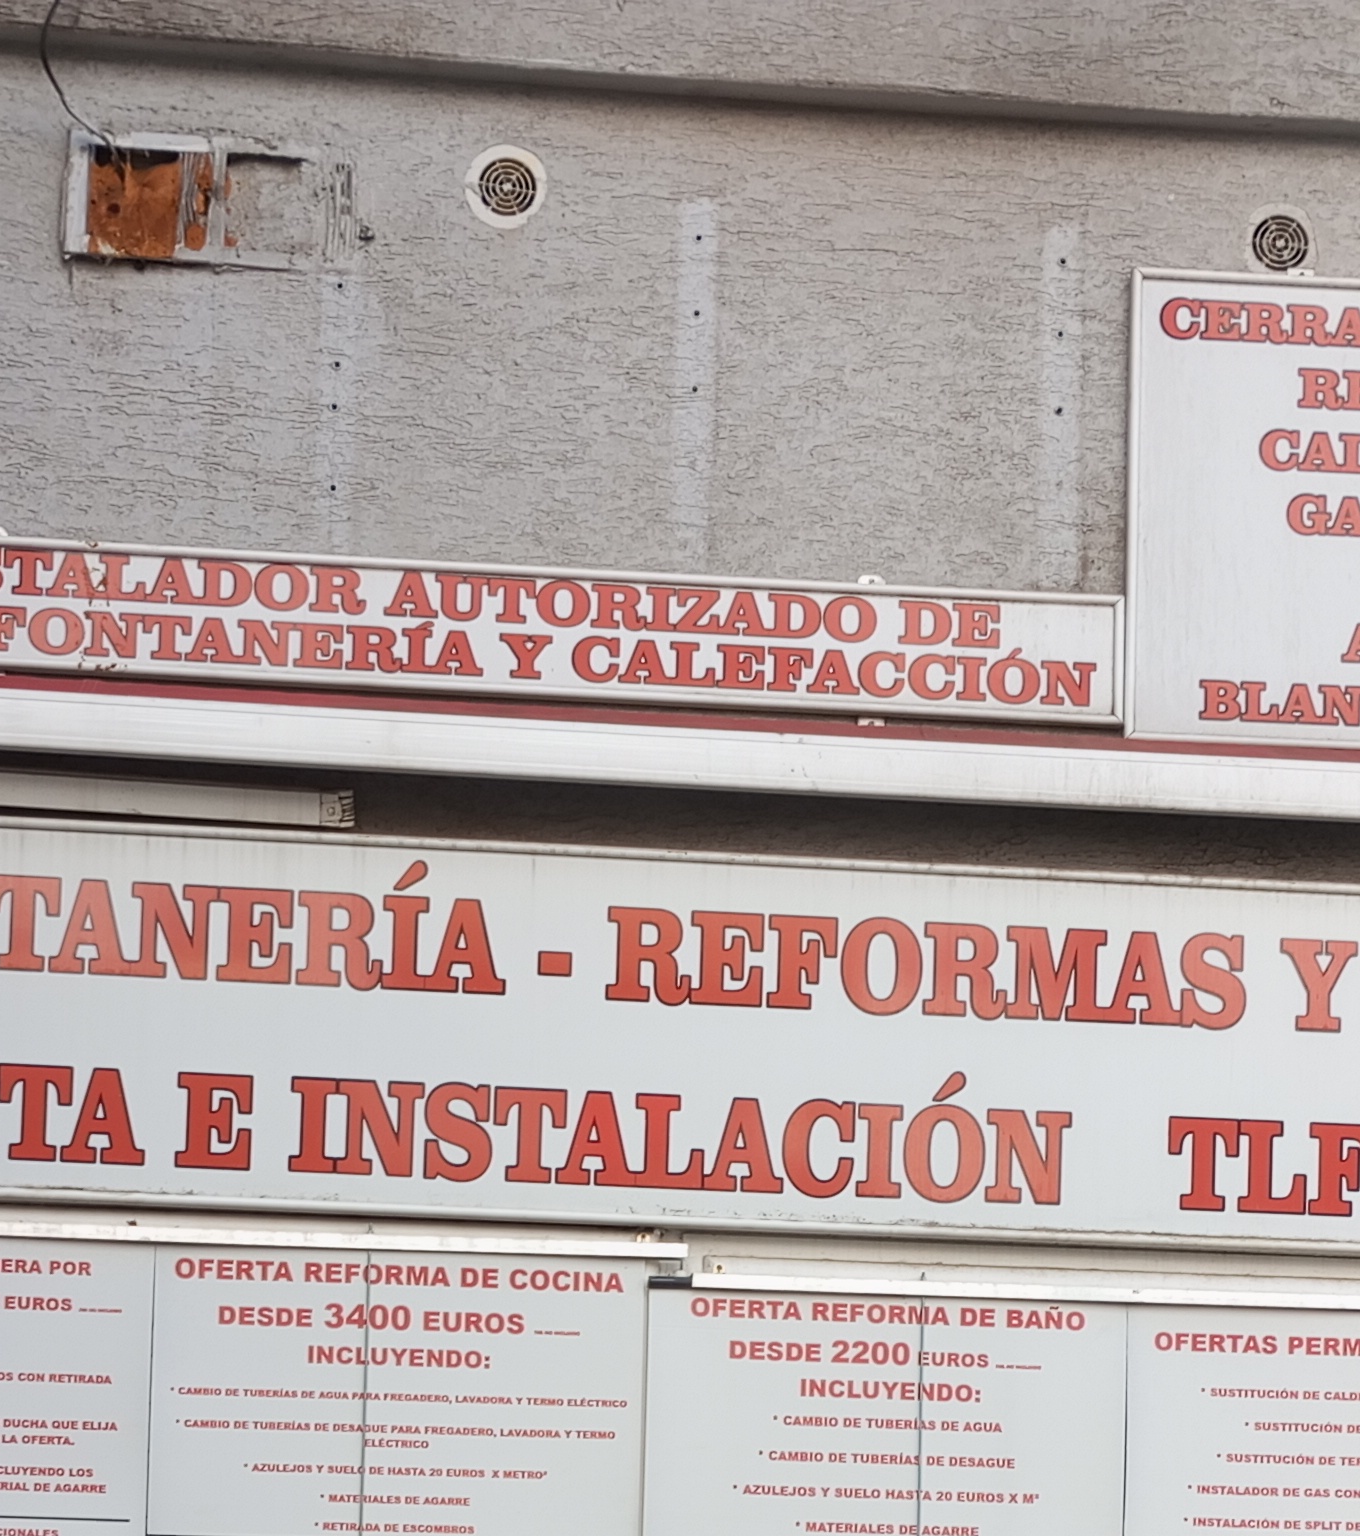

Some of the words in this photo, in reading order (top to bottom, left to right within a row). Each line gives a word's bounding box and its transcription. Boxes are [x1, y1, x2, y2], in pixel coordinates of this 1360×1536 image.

[385, 571, 876, 642] AUTORIZADO
[900, 601, 999, 647] DE
[501, 634, 552, 678] Y
[572, 630, 1095, 706] CALEFACCIÓN
[606, 907, 1245, 1029] REFORMAS
[1282, 939, 1357, 1031] Y
[175, 1073, 252, 1170] E
[289, 1073, 1071, 1203] INSTALACIÓN
[48, 1260, 92, 1276] POR
[174, 1257, 294, 1282] OFERTA
[303, 1261, 451, 1287] REFORMA
[460, 1266, 499, 1289] DE
[509, 1268, 624, 1293] COCINA
[3, 1295, 74, 1312] EUROS
[218, 1305, 313, 1328] DESDE
[325, 1302, 412, 1331] 3400
[422, 1310, 526, 1335] EUROS
[690, 1297, 802, 1320] OFERTA
[811, 1301, 950, 1325] REFORMA
[959, 1307, 997, 1328] DE
[1005, 1309, 1086, 1332] BAÑO
[306, 1345, 491, 1369] INCLUYENDO:
[728, 1340, 823, 1363] DESDE
[831, 1339, 913, 1367] 2200
[918, 1351, 990, 1369] EUROS
[1153, 1331, 1279, 1355] OFERTAS
[799, 1378, 981, 1403] INCLUYENDO:
[1254, 1420, 1343, 1434] SUSTITUCIÓN
